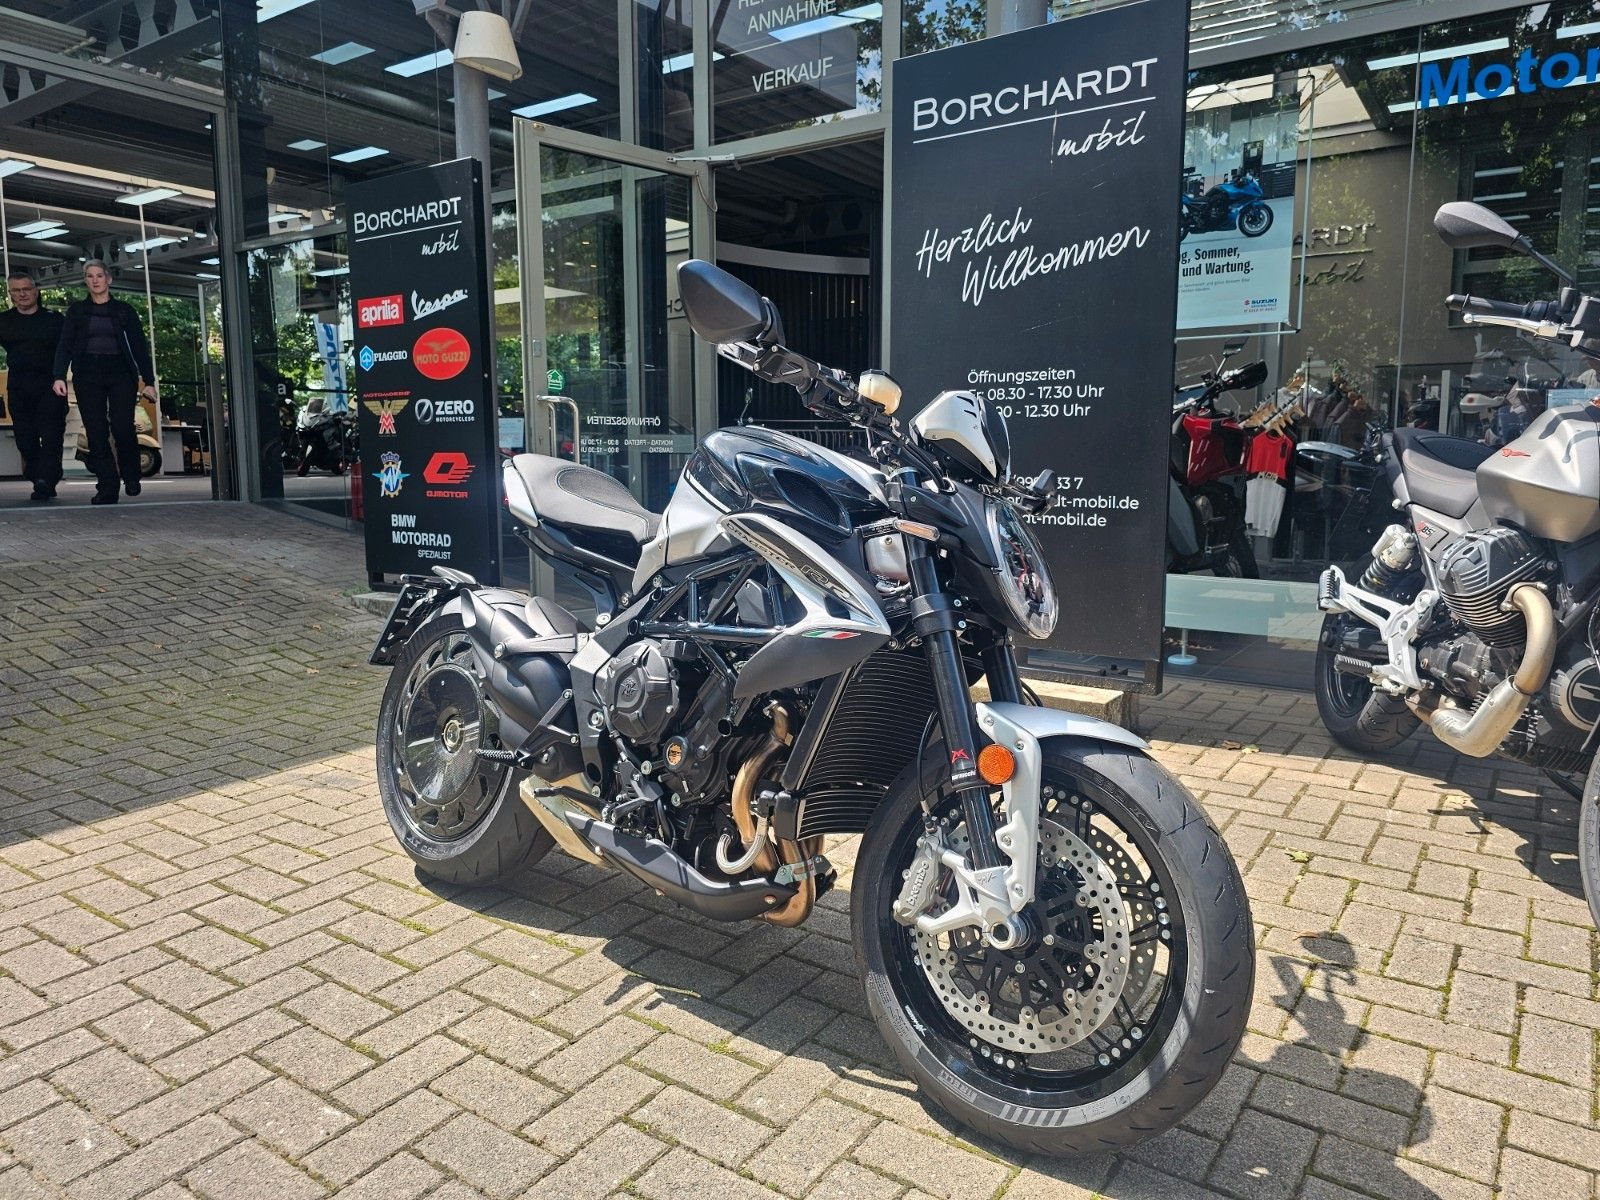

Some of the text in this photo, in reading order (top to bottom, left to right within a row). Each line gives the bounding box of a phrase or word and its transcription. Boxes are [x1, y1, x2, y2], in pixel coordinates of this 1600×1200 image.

[747, 0, 837, 35] ANNAHME
[752, 57, 833, 92] VERKAUF
[1421, 47, 1600, 109] Motor
[913, 58, 1158, 131] BORCHARDT
[1057, 110, 1145, 156] mobil
[354, 196, 462, 234] BORCHARDT
[422, 229, 459, 255] mobil
[916, 207, 1032, 278] Herzlich
[1194, 246, 1240, 261] Sommer,
[962, 226, 1150, 307] Willkommen
[1182, 260, 1254, 277] und Wartung.
[361, 299, 400, 326] aprilia
[411, 288, 469, 321] Vespa
[374, 350, 408, 362] PIAGGIO
[416, 351, 467, 364] MOTO GUZZI
[967, 367, 1076, 385] Öffnungszeiten
[987, 388, 1026, 401] 08.30
[1038, 386, 1072, 399] 17.30
[1076, 384, 1105, 398] Uhr
[435, 399, 475, 415] ZERO
[1024, 404, 1059, 418] 12.30
[1063, 403, 1091, 417] Uhr
[1073, 477, 1084, 490] 7
[391, 513, 416, 528] BMW
[391, 530, 452, 548] MOTORRAD
[417, 549, 452, 560] SPEZIALIST
